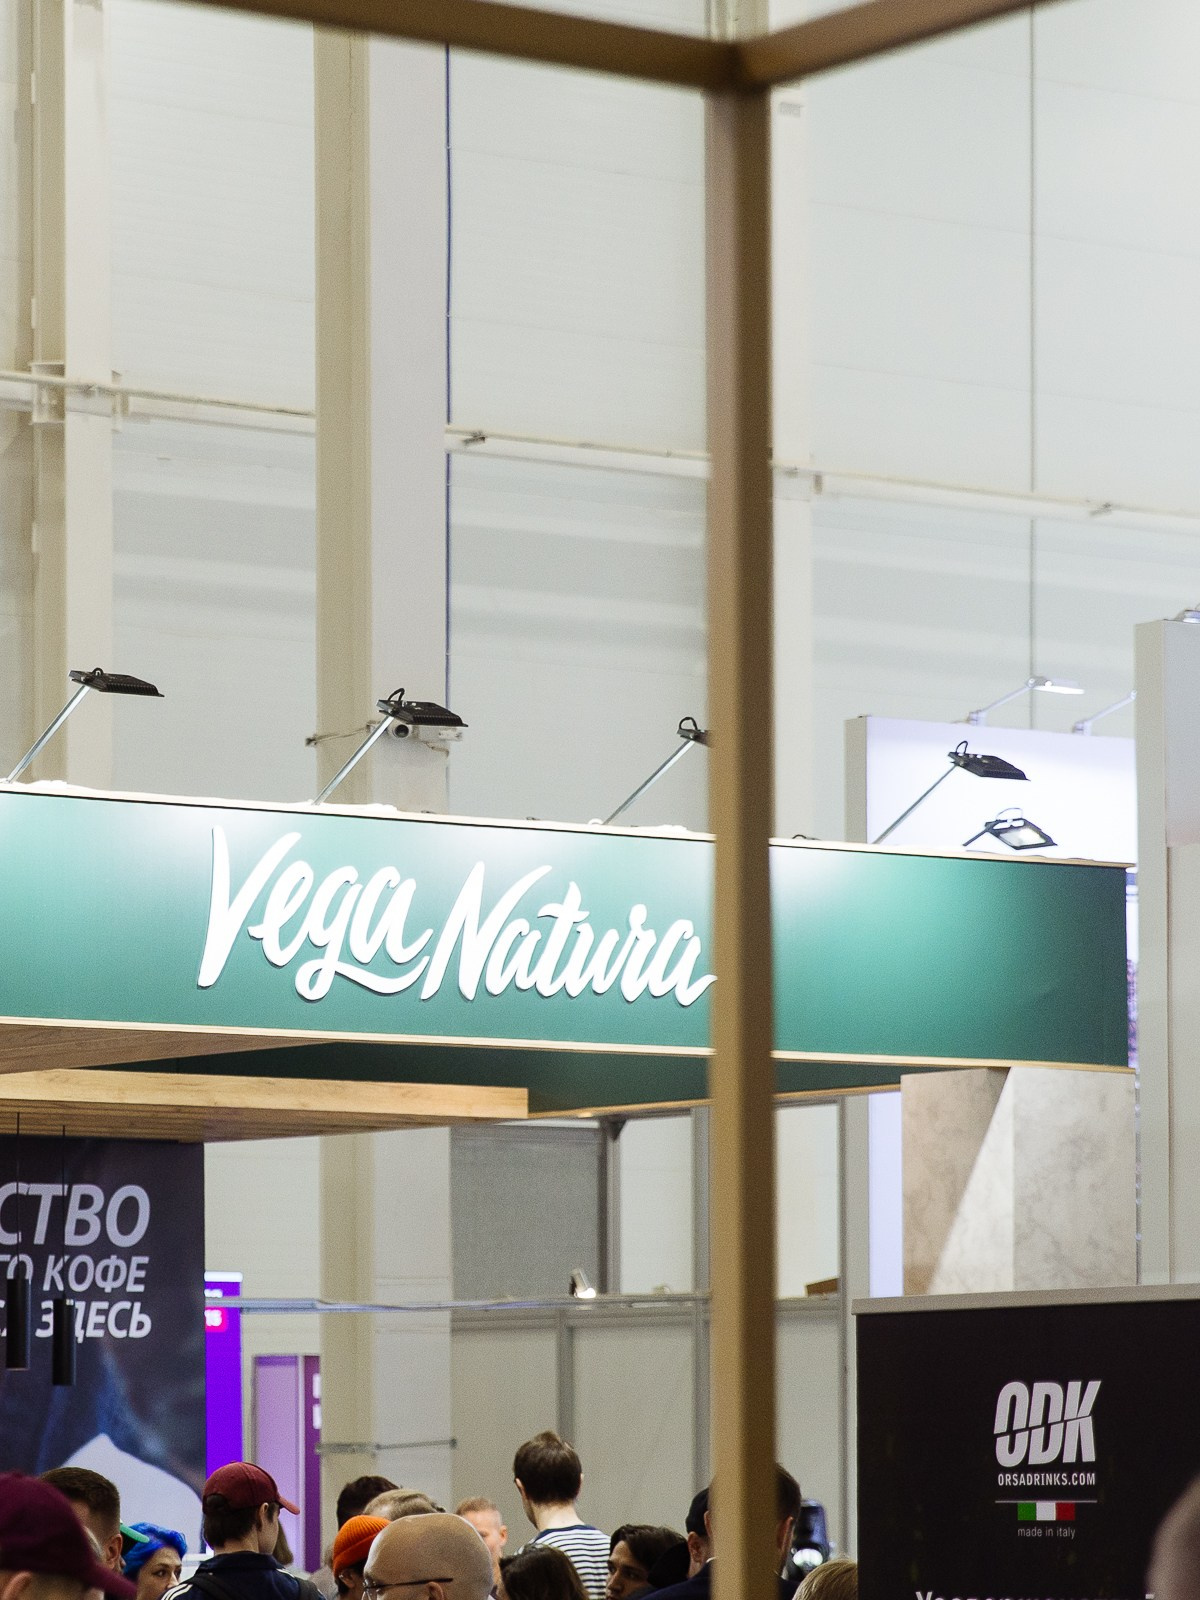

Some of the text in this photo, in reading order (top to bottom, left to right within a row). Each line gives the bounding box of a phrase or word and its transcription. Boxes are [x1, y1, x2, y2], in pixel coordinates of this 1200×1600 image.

[197, 825, 718, 1007] Vega Natura
[42, 1254, 149, 1293] КОФЕ
[993, 1380, 1101, 1468] ODK
[997, 1473, 1096, 1486] ORSADRINKS.COM
[1017, 1526, 1076, 1539] made in italy
